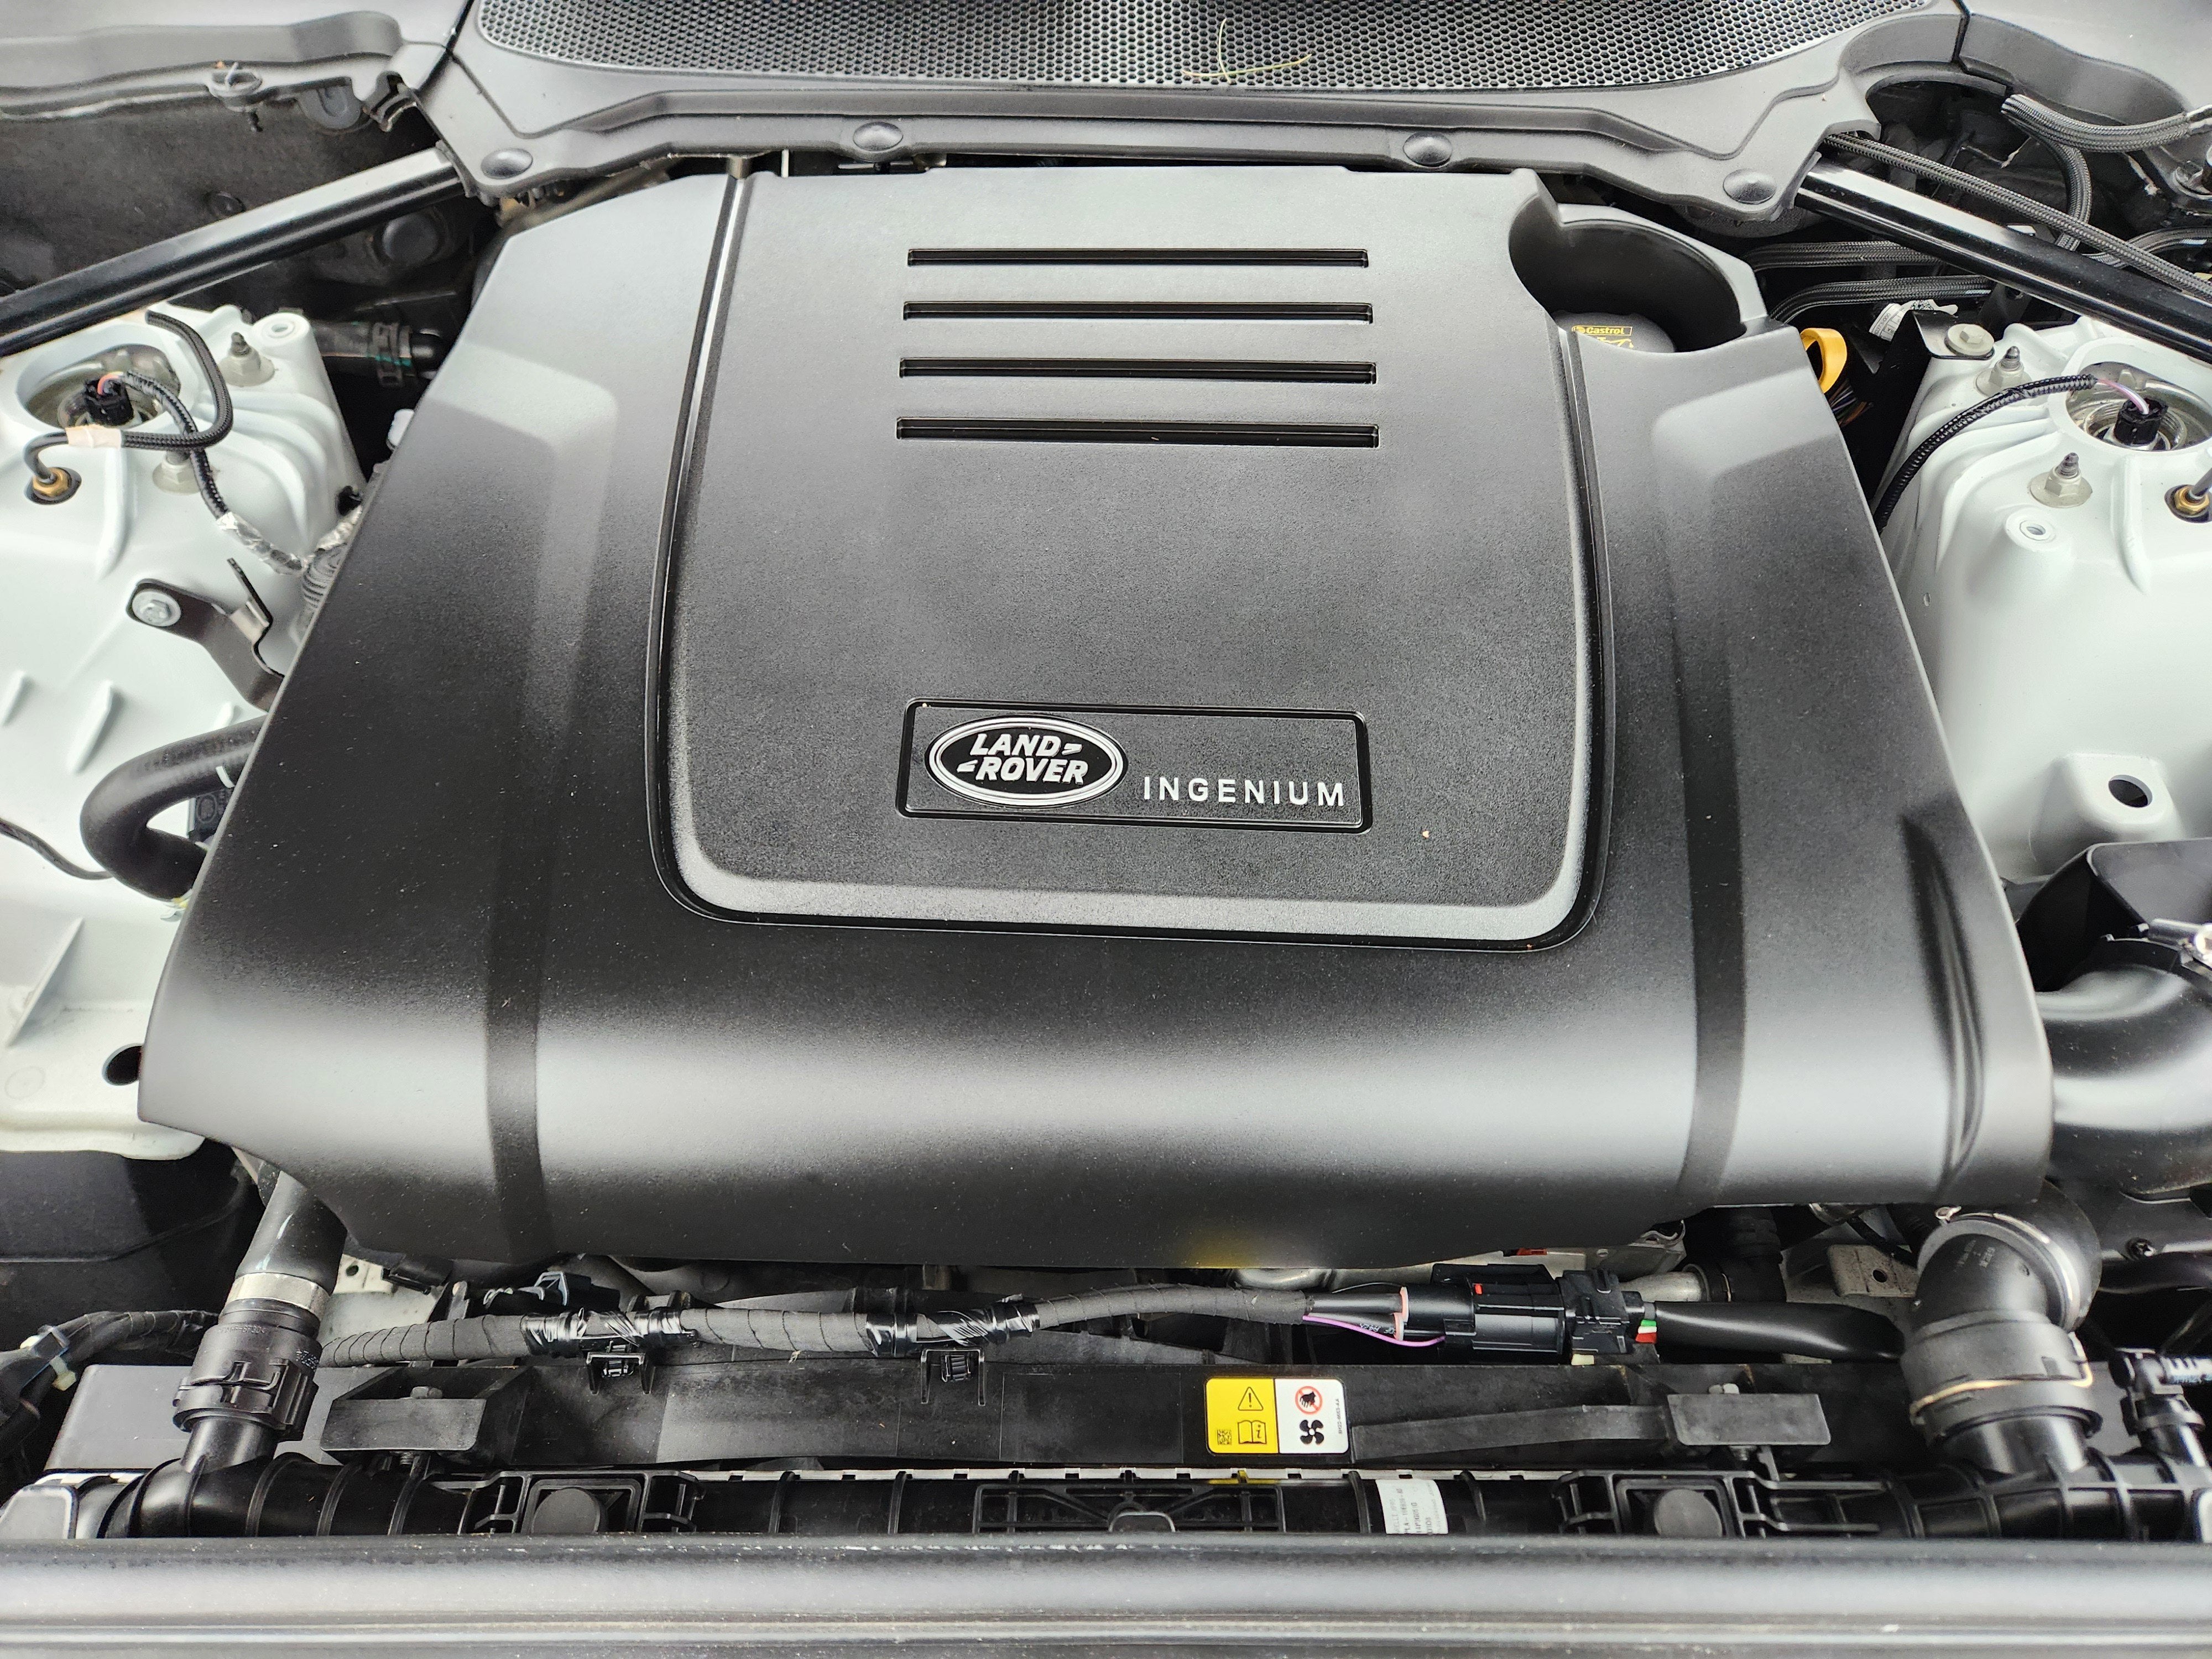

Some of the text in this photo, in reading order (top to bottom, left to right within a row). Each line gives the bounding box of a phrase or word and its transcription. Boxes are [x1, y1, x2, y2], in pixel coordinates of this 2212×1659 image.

[1585, 326, 1625, 335] Castrol
[969, 733, 1061, 757] LAND
[975, 756, 1089, 785] ROVER
[1144, 776, 1344, 807] INGENIUM
